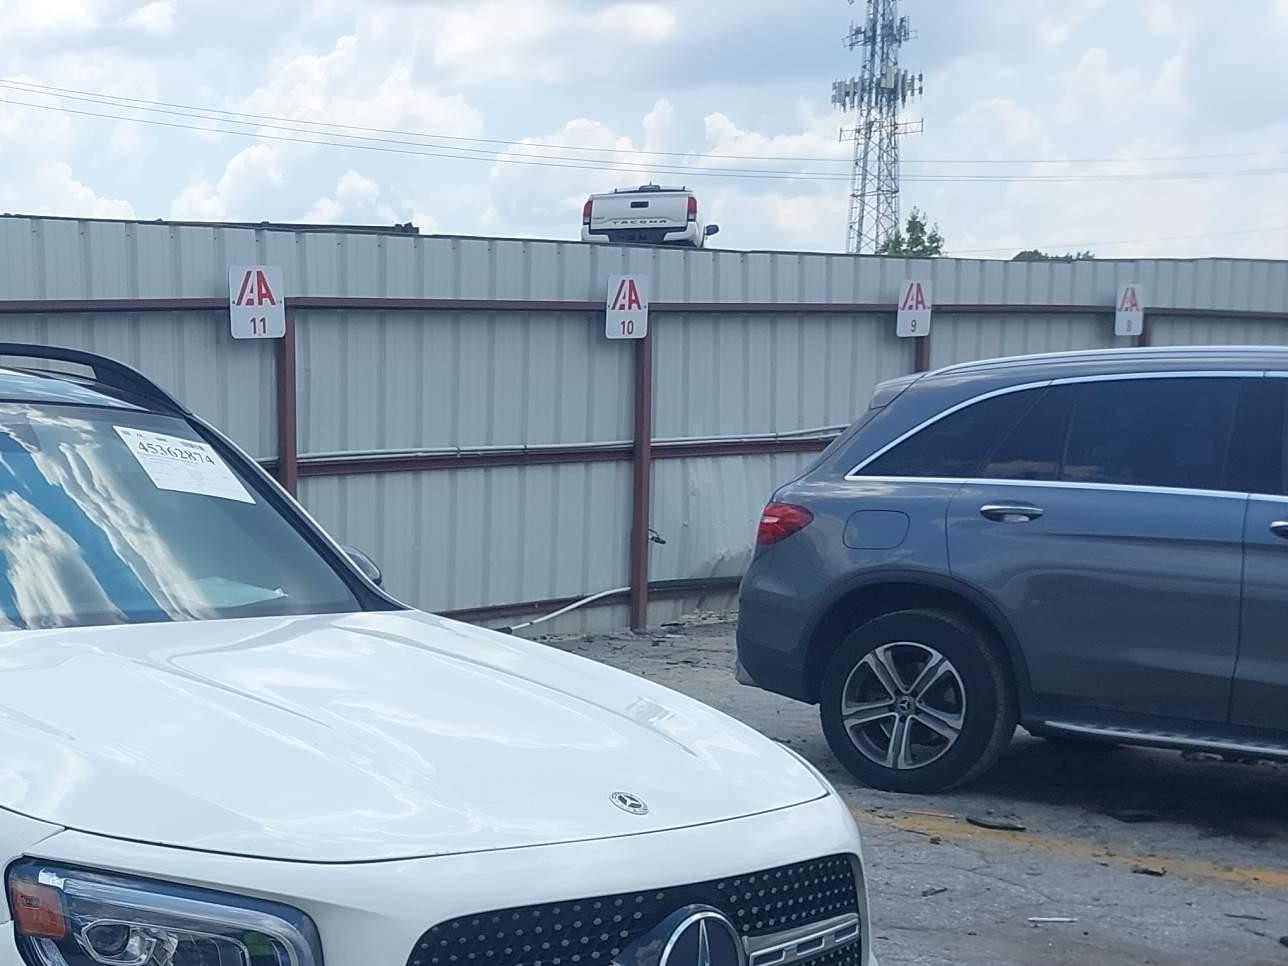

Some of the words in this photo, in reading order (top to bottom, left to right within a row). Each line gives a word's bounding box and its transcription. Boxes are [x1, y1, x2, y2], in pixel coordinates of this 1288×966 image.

[250, 317, 266, 334] 11
[621, 320, 634, 335] 10
[911, 319, 917, 333] 9
[137, 441, 216, 466] 45362874
